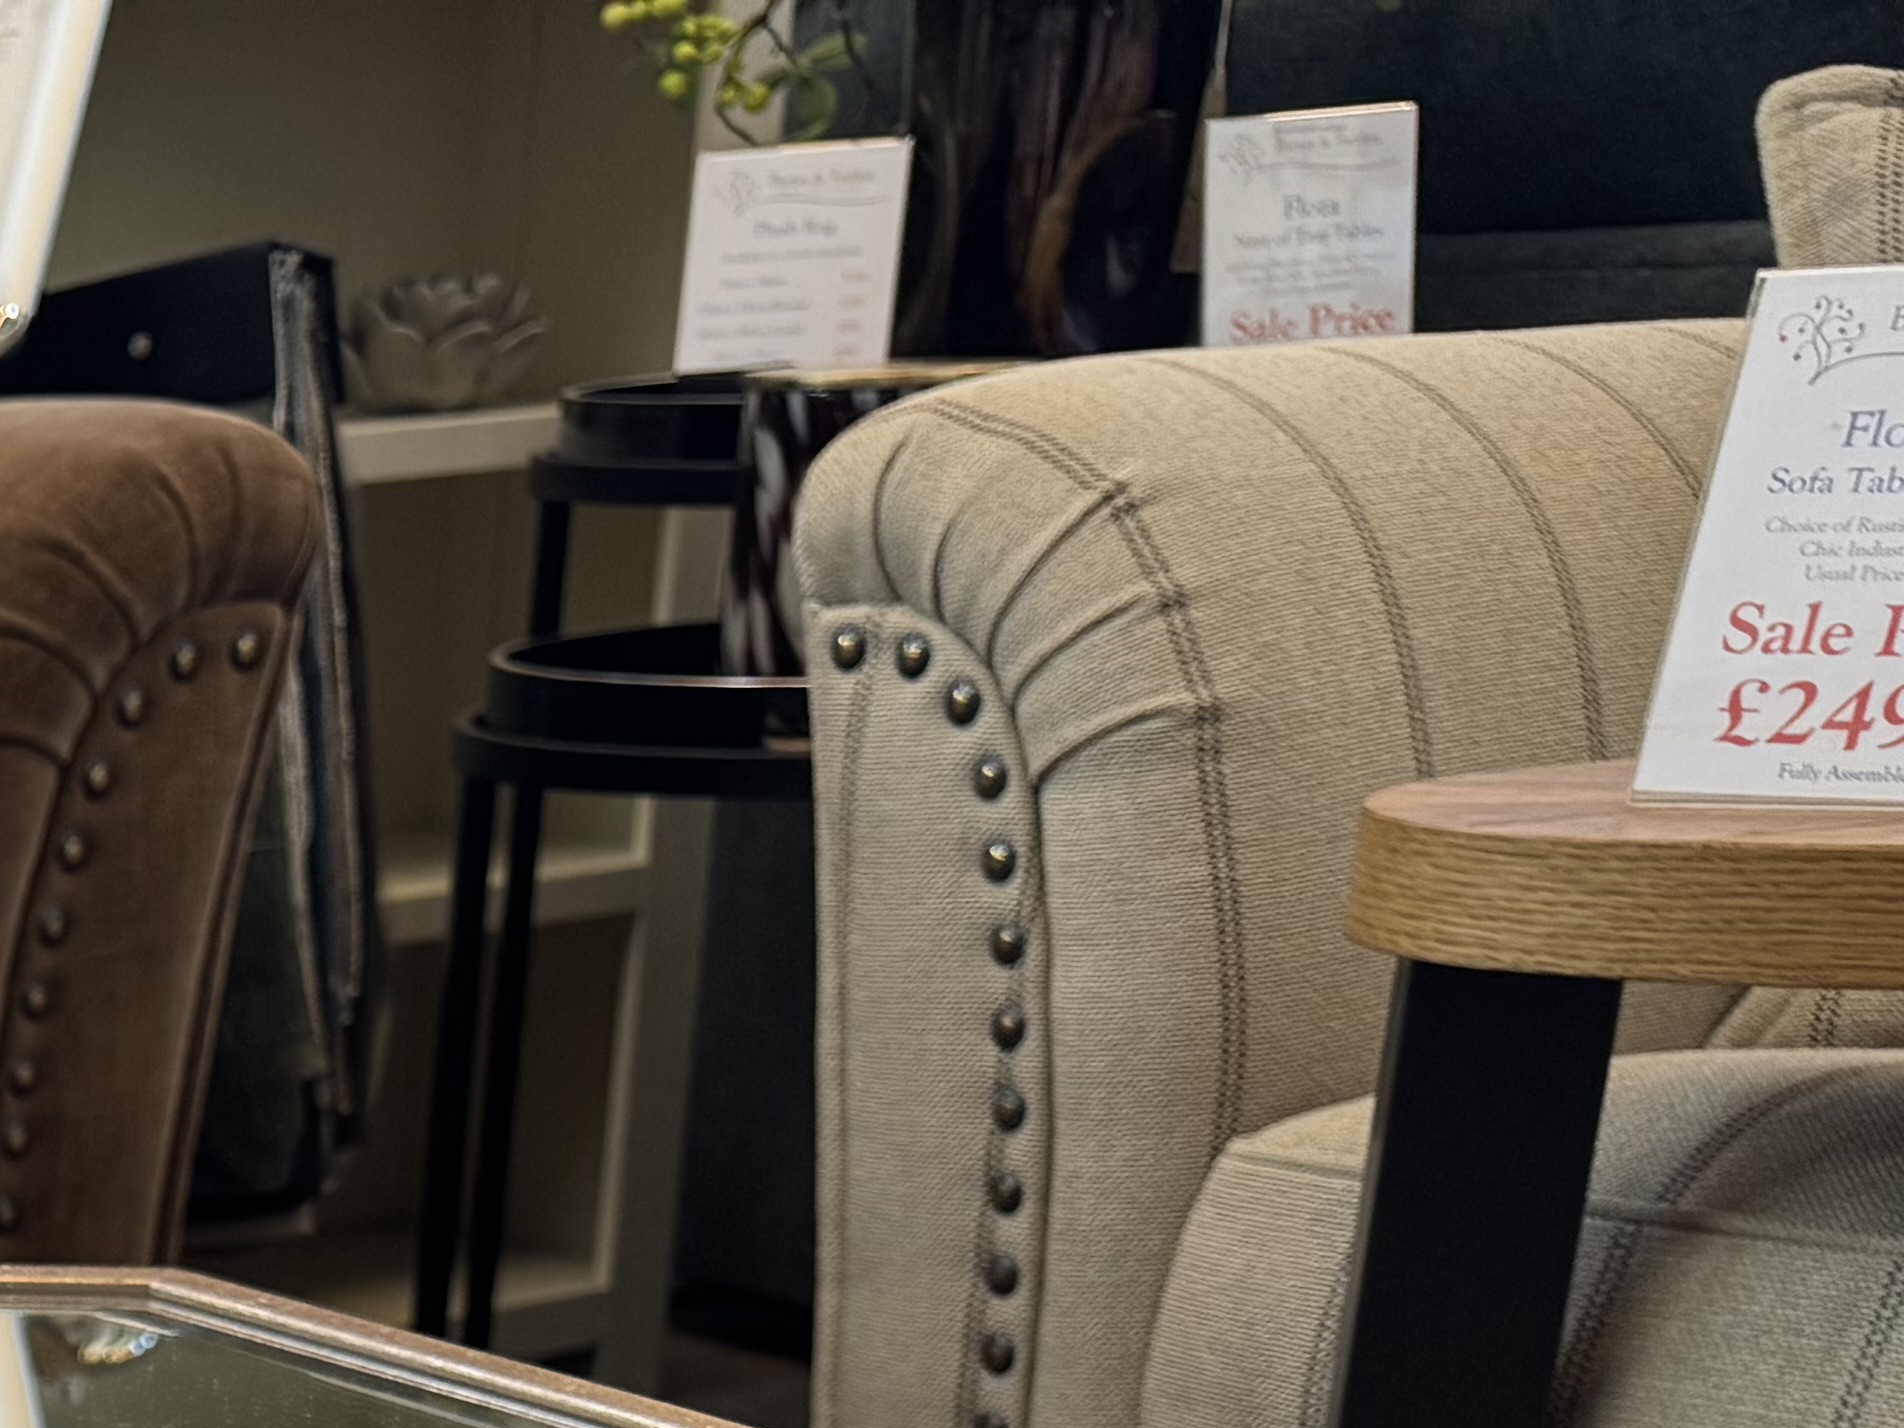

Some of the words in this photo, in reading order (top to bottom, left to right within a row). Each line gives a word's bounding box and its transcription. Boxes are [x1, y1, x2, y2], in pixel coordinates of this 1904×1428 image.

[1230, 306, 1298, 344] Sale
[1309, 302, 1395, 337] Price
[1767, 465, 1834, 494] Sofa
[1765, 516, 1828, 533] Choice
[1831, 516, 1853, 533] of
[1799, 540, 1843, 557] Chic
[1805, 564, 1856, 581] Usual
[1722, 601, 1854, 656] Sale
[1713, 678, 1904, 752] £249
[1778, 762, 1822, 784] Fully
